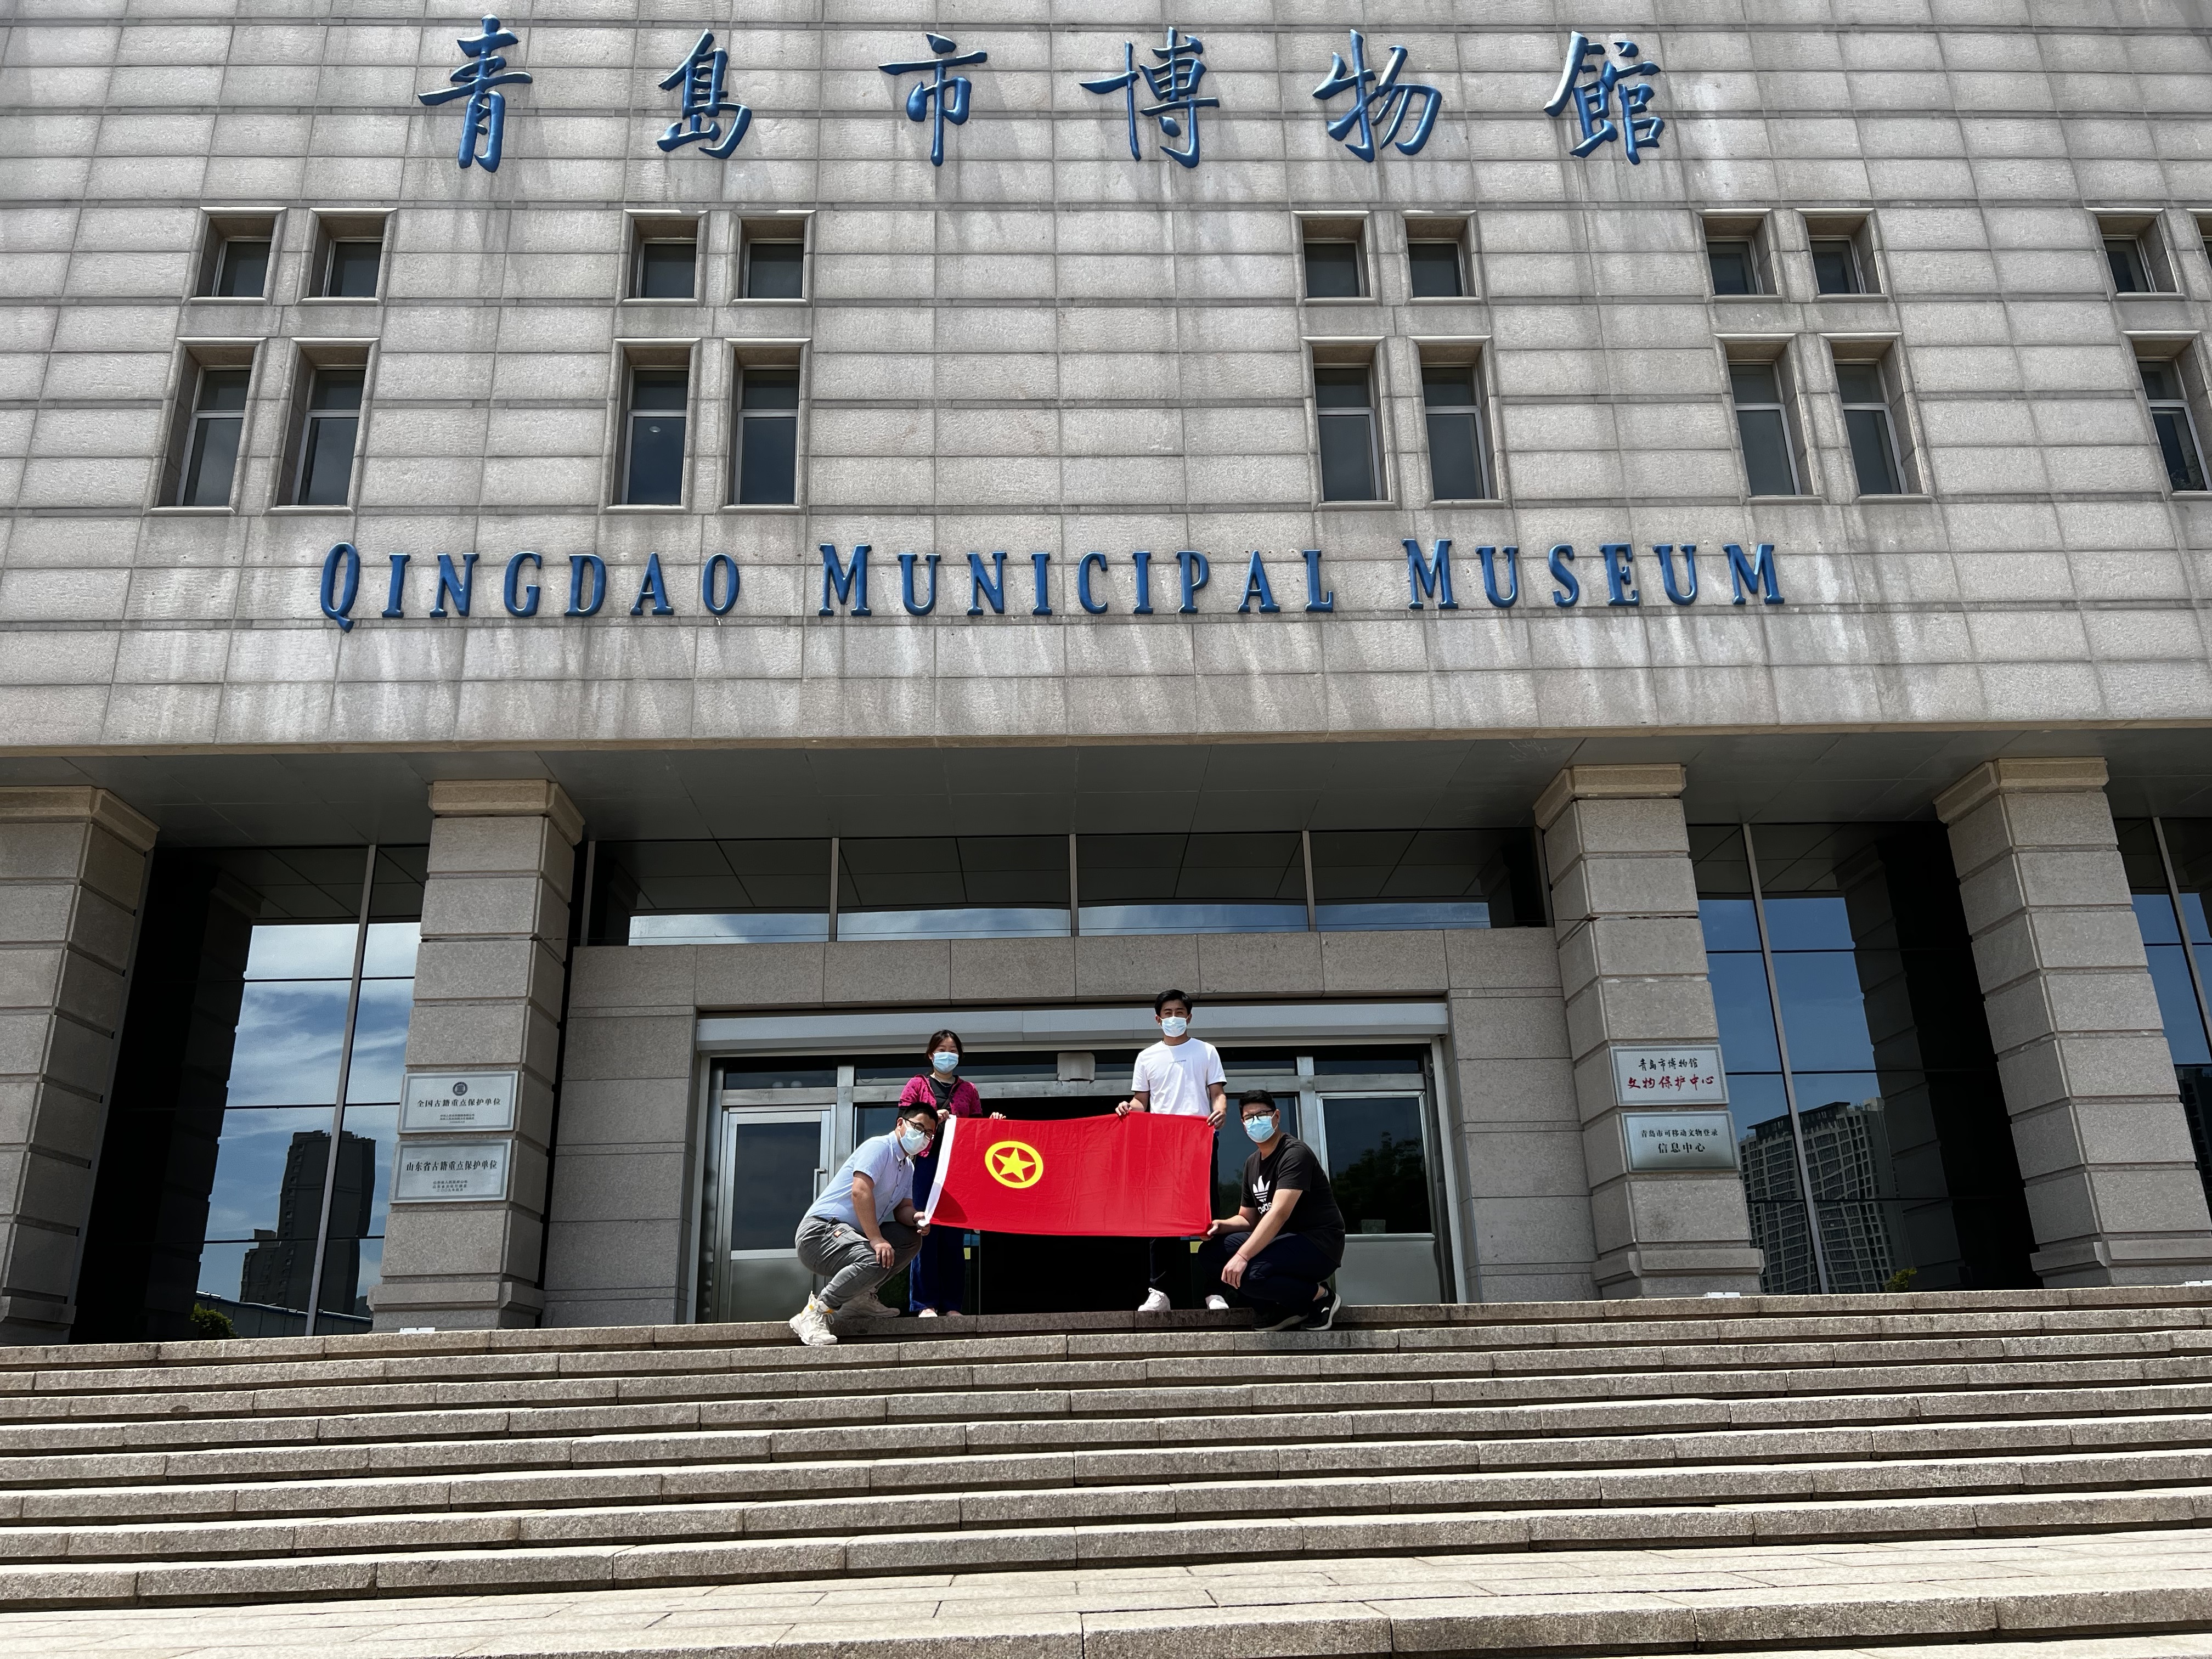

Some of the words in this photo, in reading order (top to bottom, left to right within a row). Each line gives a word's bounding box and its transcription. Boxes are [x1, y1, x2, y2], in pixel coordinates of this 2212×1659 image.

[320, 542, 741, 633] QINGDAO
[818, 543, 1334, 617] MUNICIPAL
[1401, 538, 1785, 610] MUSEUM
[1638, 1057, 1698, 1071] 青岛市博物馆
[1627, 1074, 1714, 1091] 文物保护中心
[417, 1098, 501, 1108] 全国古籍重点保护单位
[1658, 1142, 1705, 1154] 信息中心
[406, 1160, 498, 1172] 山东省古籍重点保护单位
